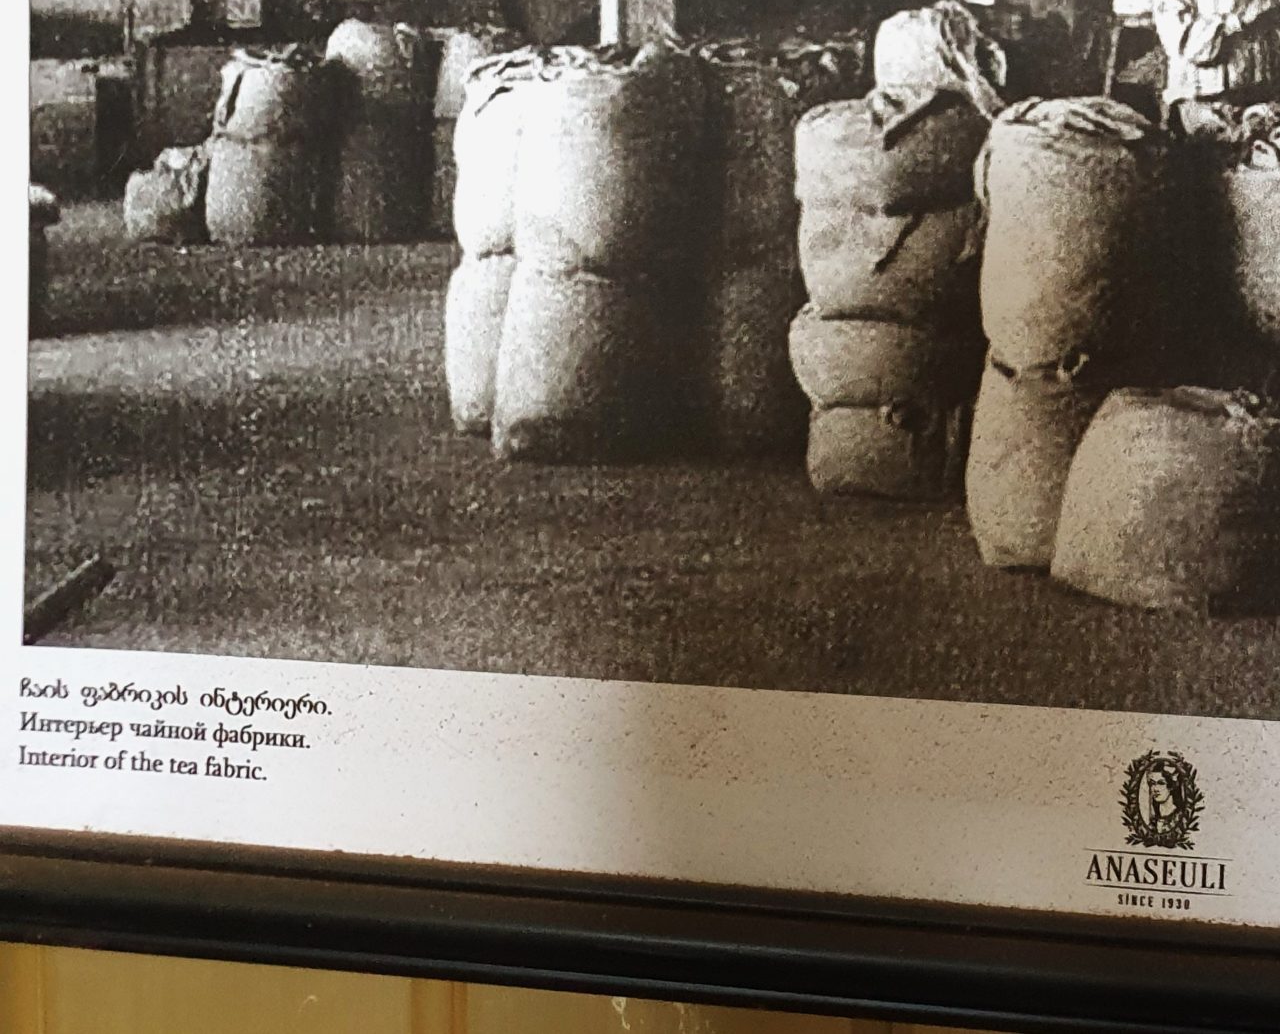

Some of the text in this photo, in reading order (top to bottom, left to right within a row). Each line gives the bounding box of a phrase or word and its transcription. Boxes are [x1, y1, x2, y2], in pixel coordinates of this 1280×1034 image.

[19, 677, 333, 719] ჩაის ფაბრიკის ინტერიერი.
[20, 711, 311, 751] Интерьер чайной фабрики.
[19, 746, 267, 781] Interior of the tea fabric.
[1086, 853, 1226, 890] ANASEULI
[1118, 893, 1191, 910] SINCE 1930
